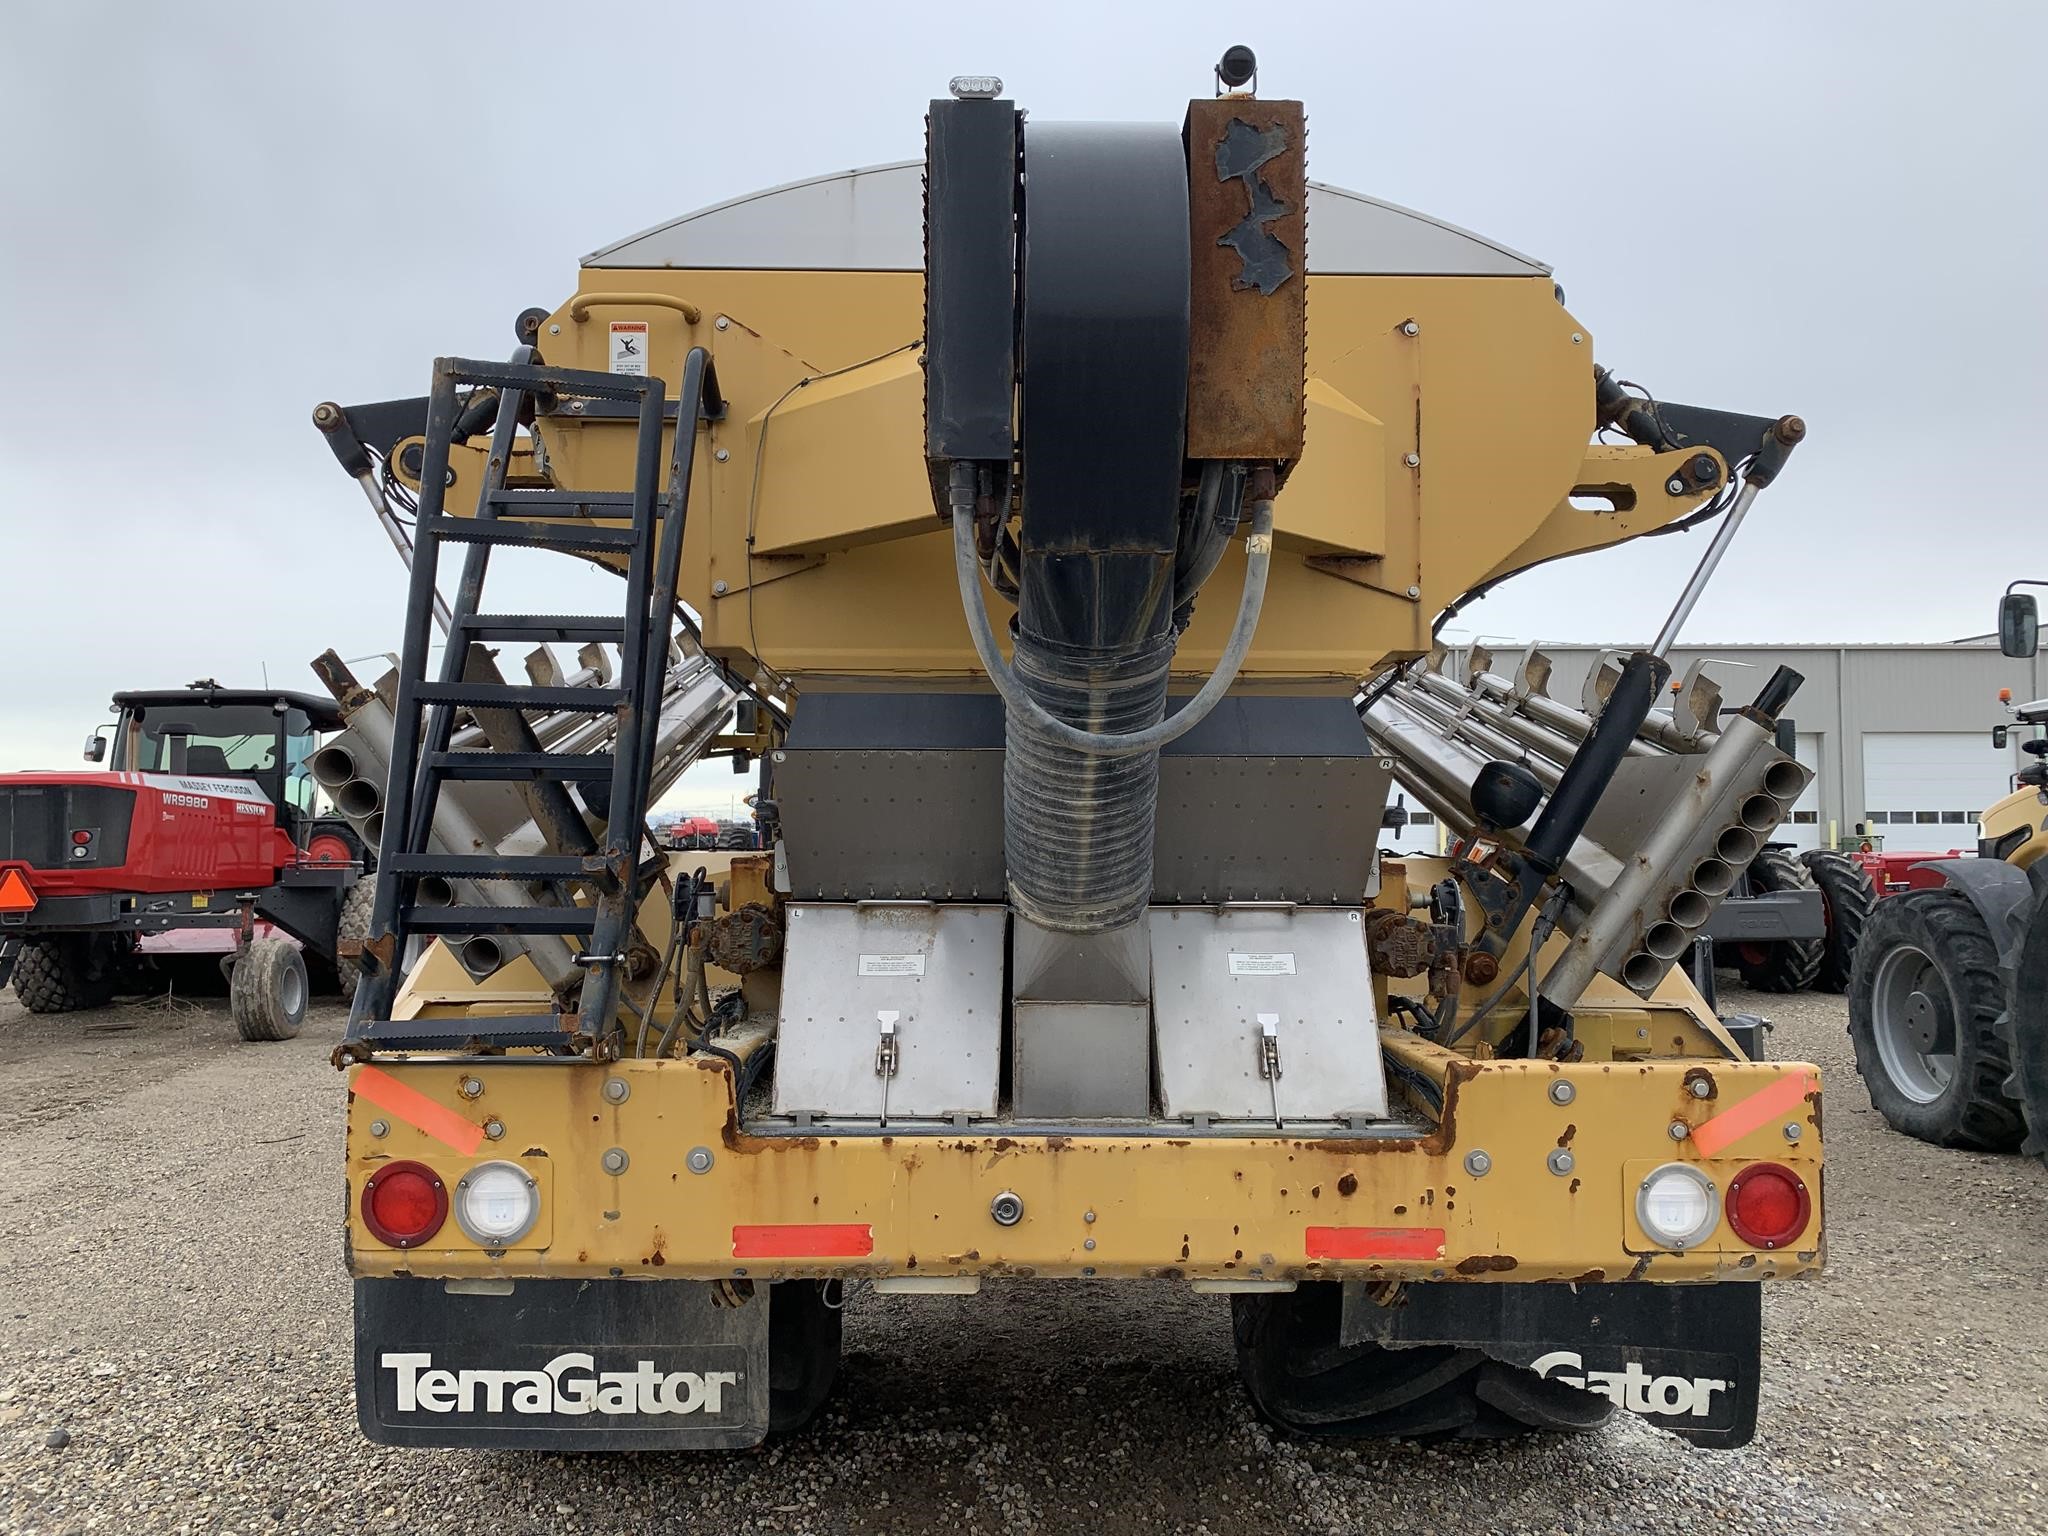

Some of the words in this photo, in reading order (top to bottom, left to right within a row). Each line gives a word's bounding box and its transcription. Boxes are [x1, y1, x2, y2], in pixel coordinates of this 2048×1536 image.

[179, 780, 212, 791] MASSEY
[212, 784, 252, 795] FERGUSON
[162, 792, 209, 809] WR9980
[236, 802, 266, 816] HESSTON
[381, 1352, 736, 1415] TerraGator
